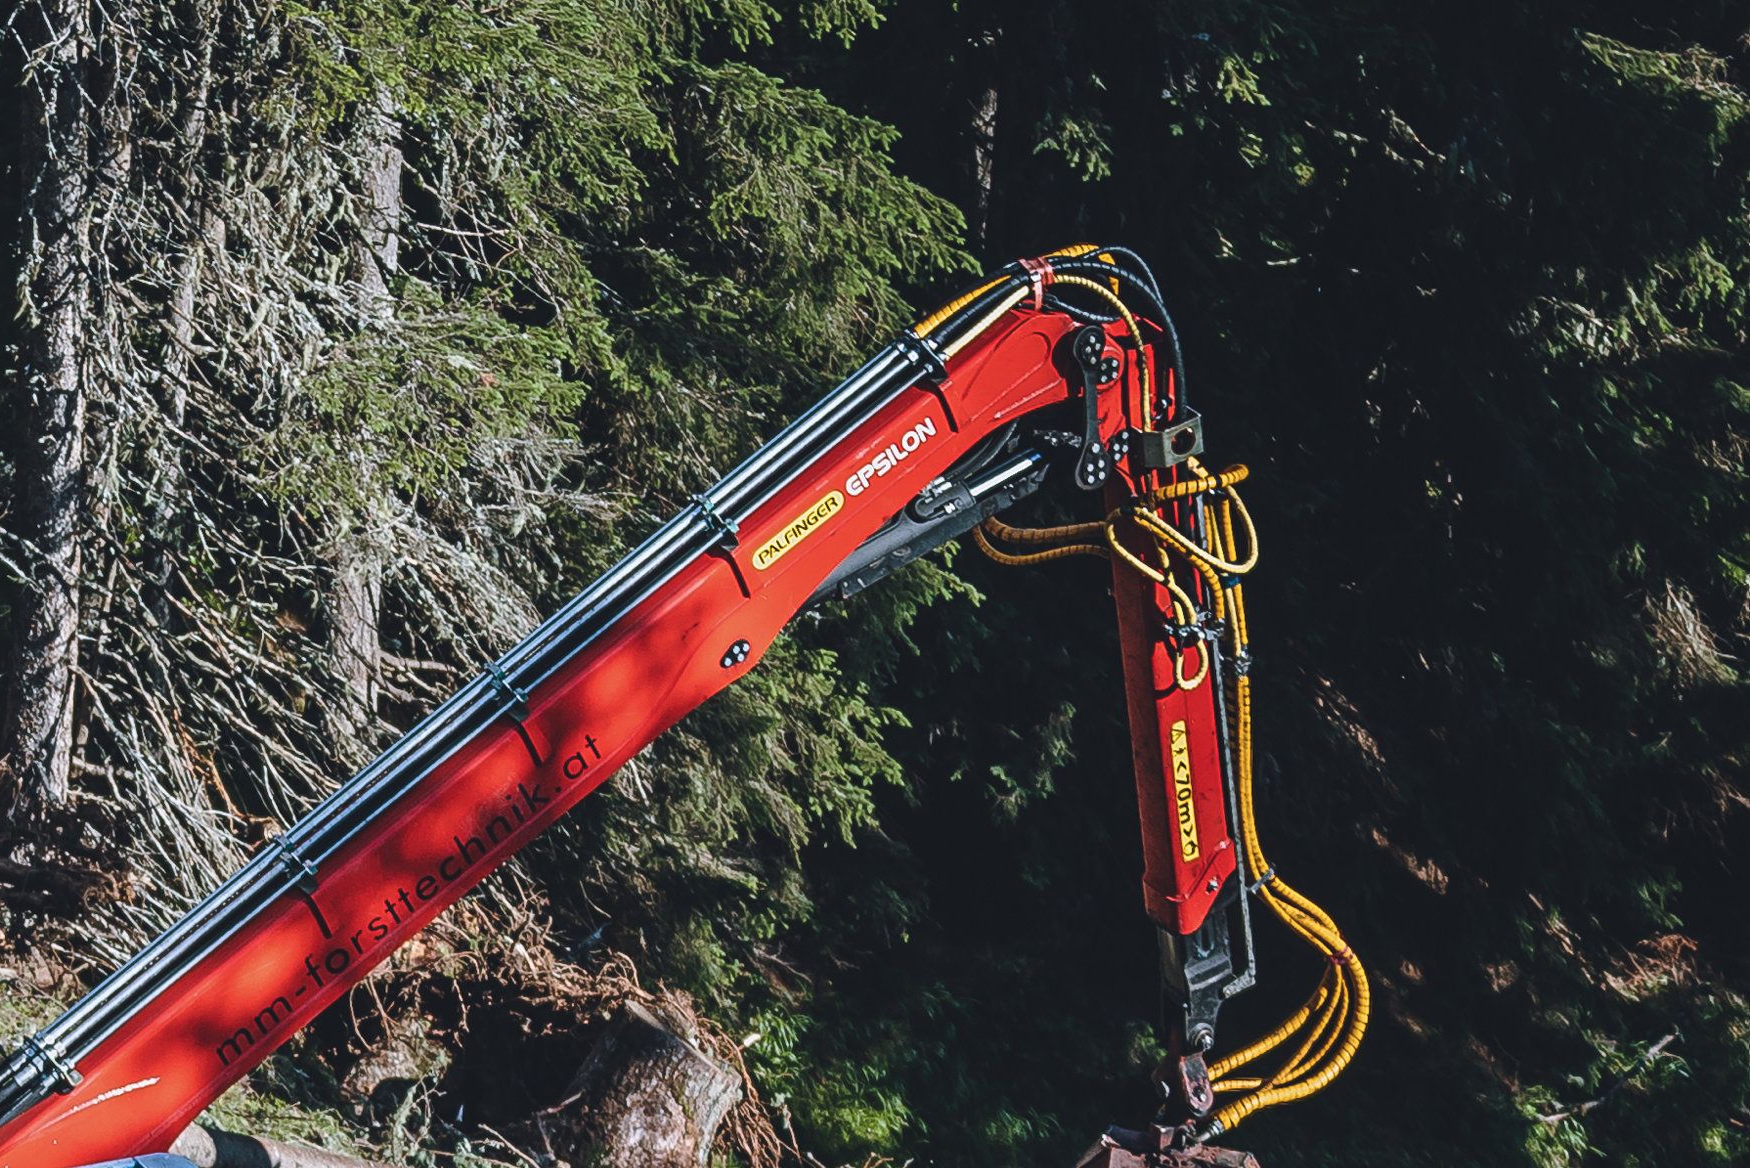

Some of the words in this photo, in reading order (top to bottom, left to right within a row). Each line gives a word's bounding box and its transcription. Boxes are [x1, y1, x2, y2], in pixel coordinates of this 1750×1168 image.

[757, 496, 840, 565] PALFINGER
[845, 417, 936, 496] EPSILON
[216, 734, 603, 1067] mm-forsttechnik.at
